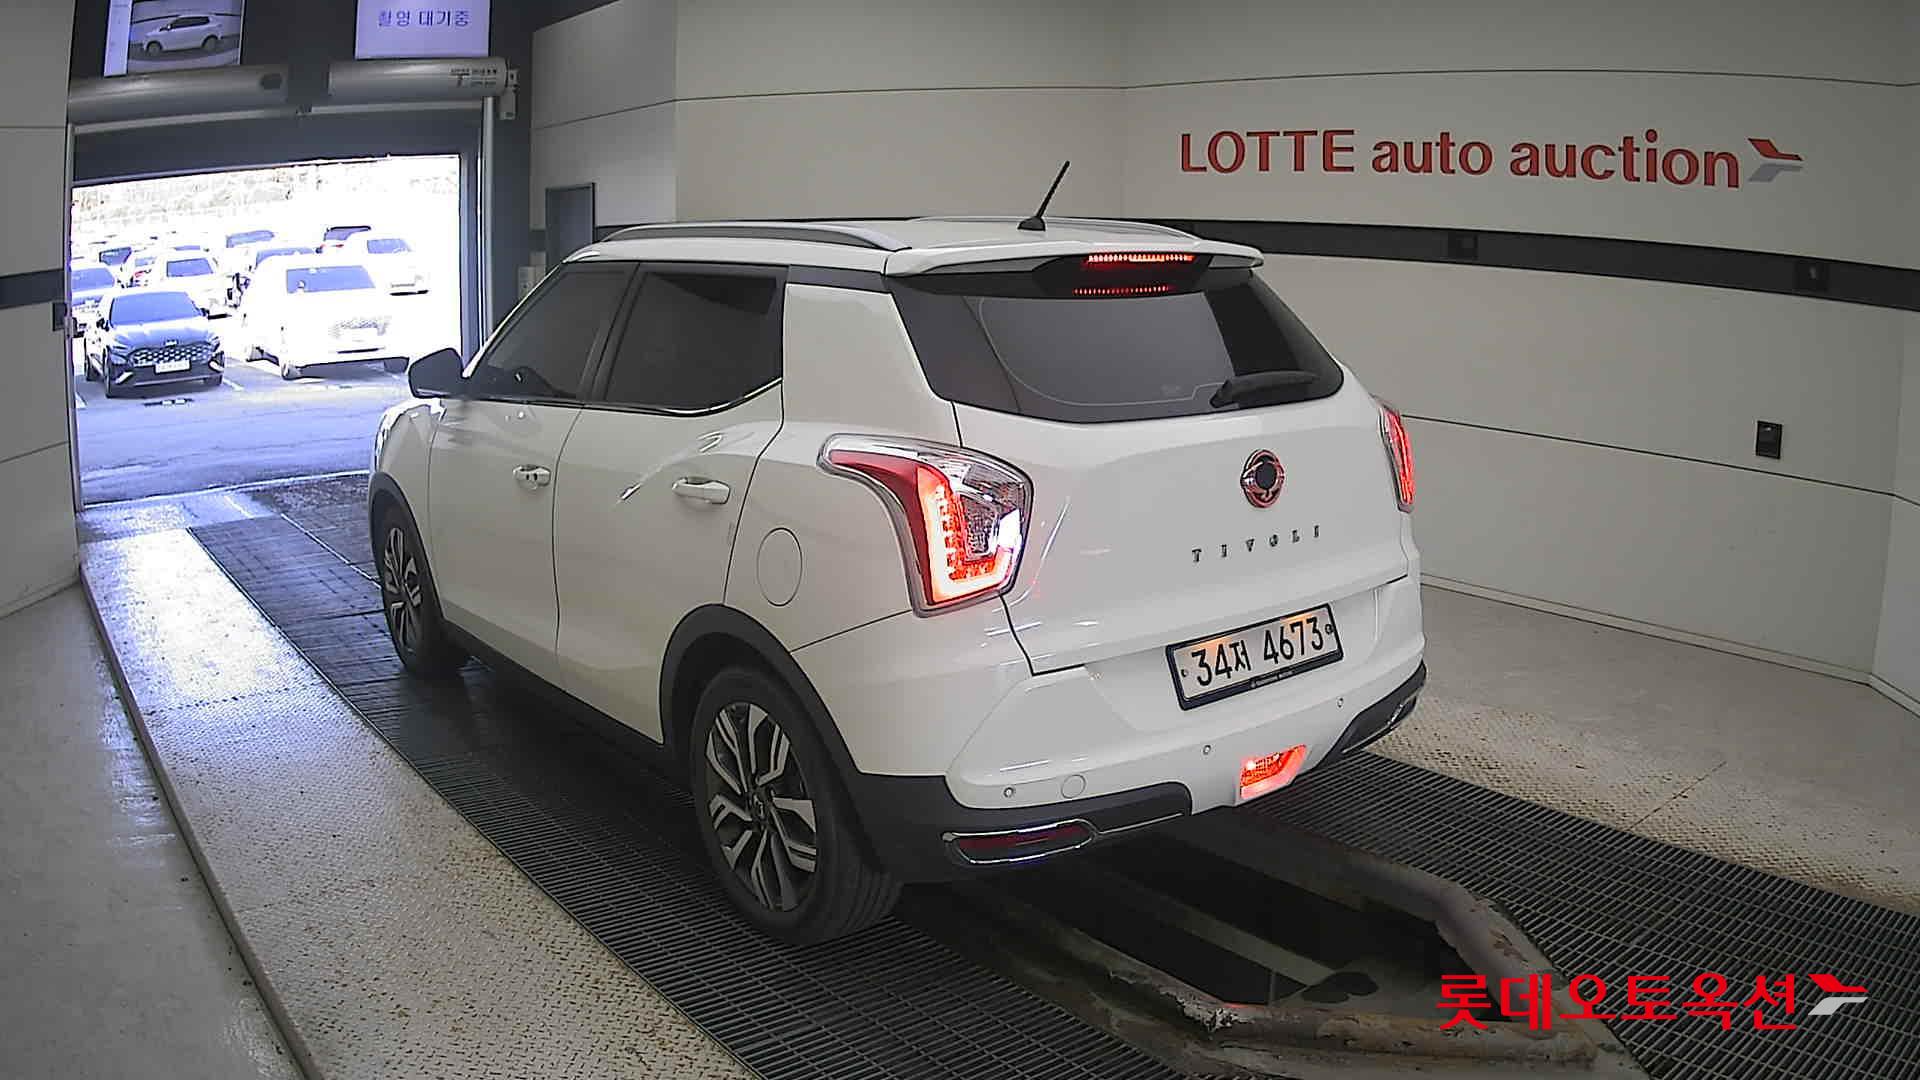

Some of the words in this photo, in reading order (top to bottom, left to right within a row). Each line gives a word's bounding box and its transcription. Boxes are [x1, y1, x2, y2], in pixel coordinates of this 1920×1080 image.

[418, 10, 471, 27] 대기중
[1181, 129, 1355, 174] LOTTE
[1371, 131, 1494, 176] auto
[1510, 128, 1740, 189] auction
[1191, 524, 1320, 563] TIVOLI
[1191, 639, 1252, 686] 34저
[1263, 616, 1324, 666] 4673
